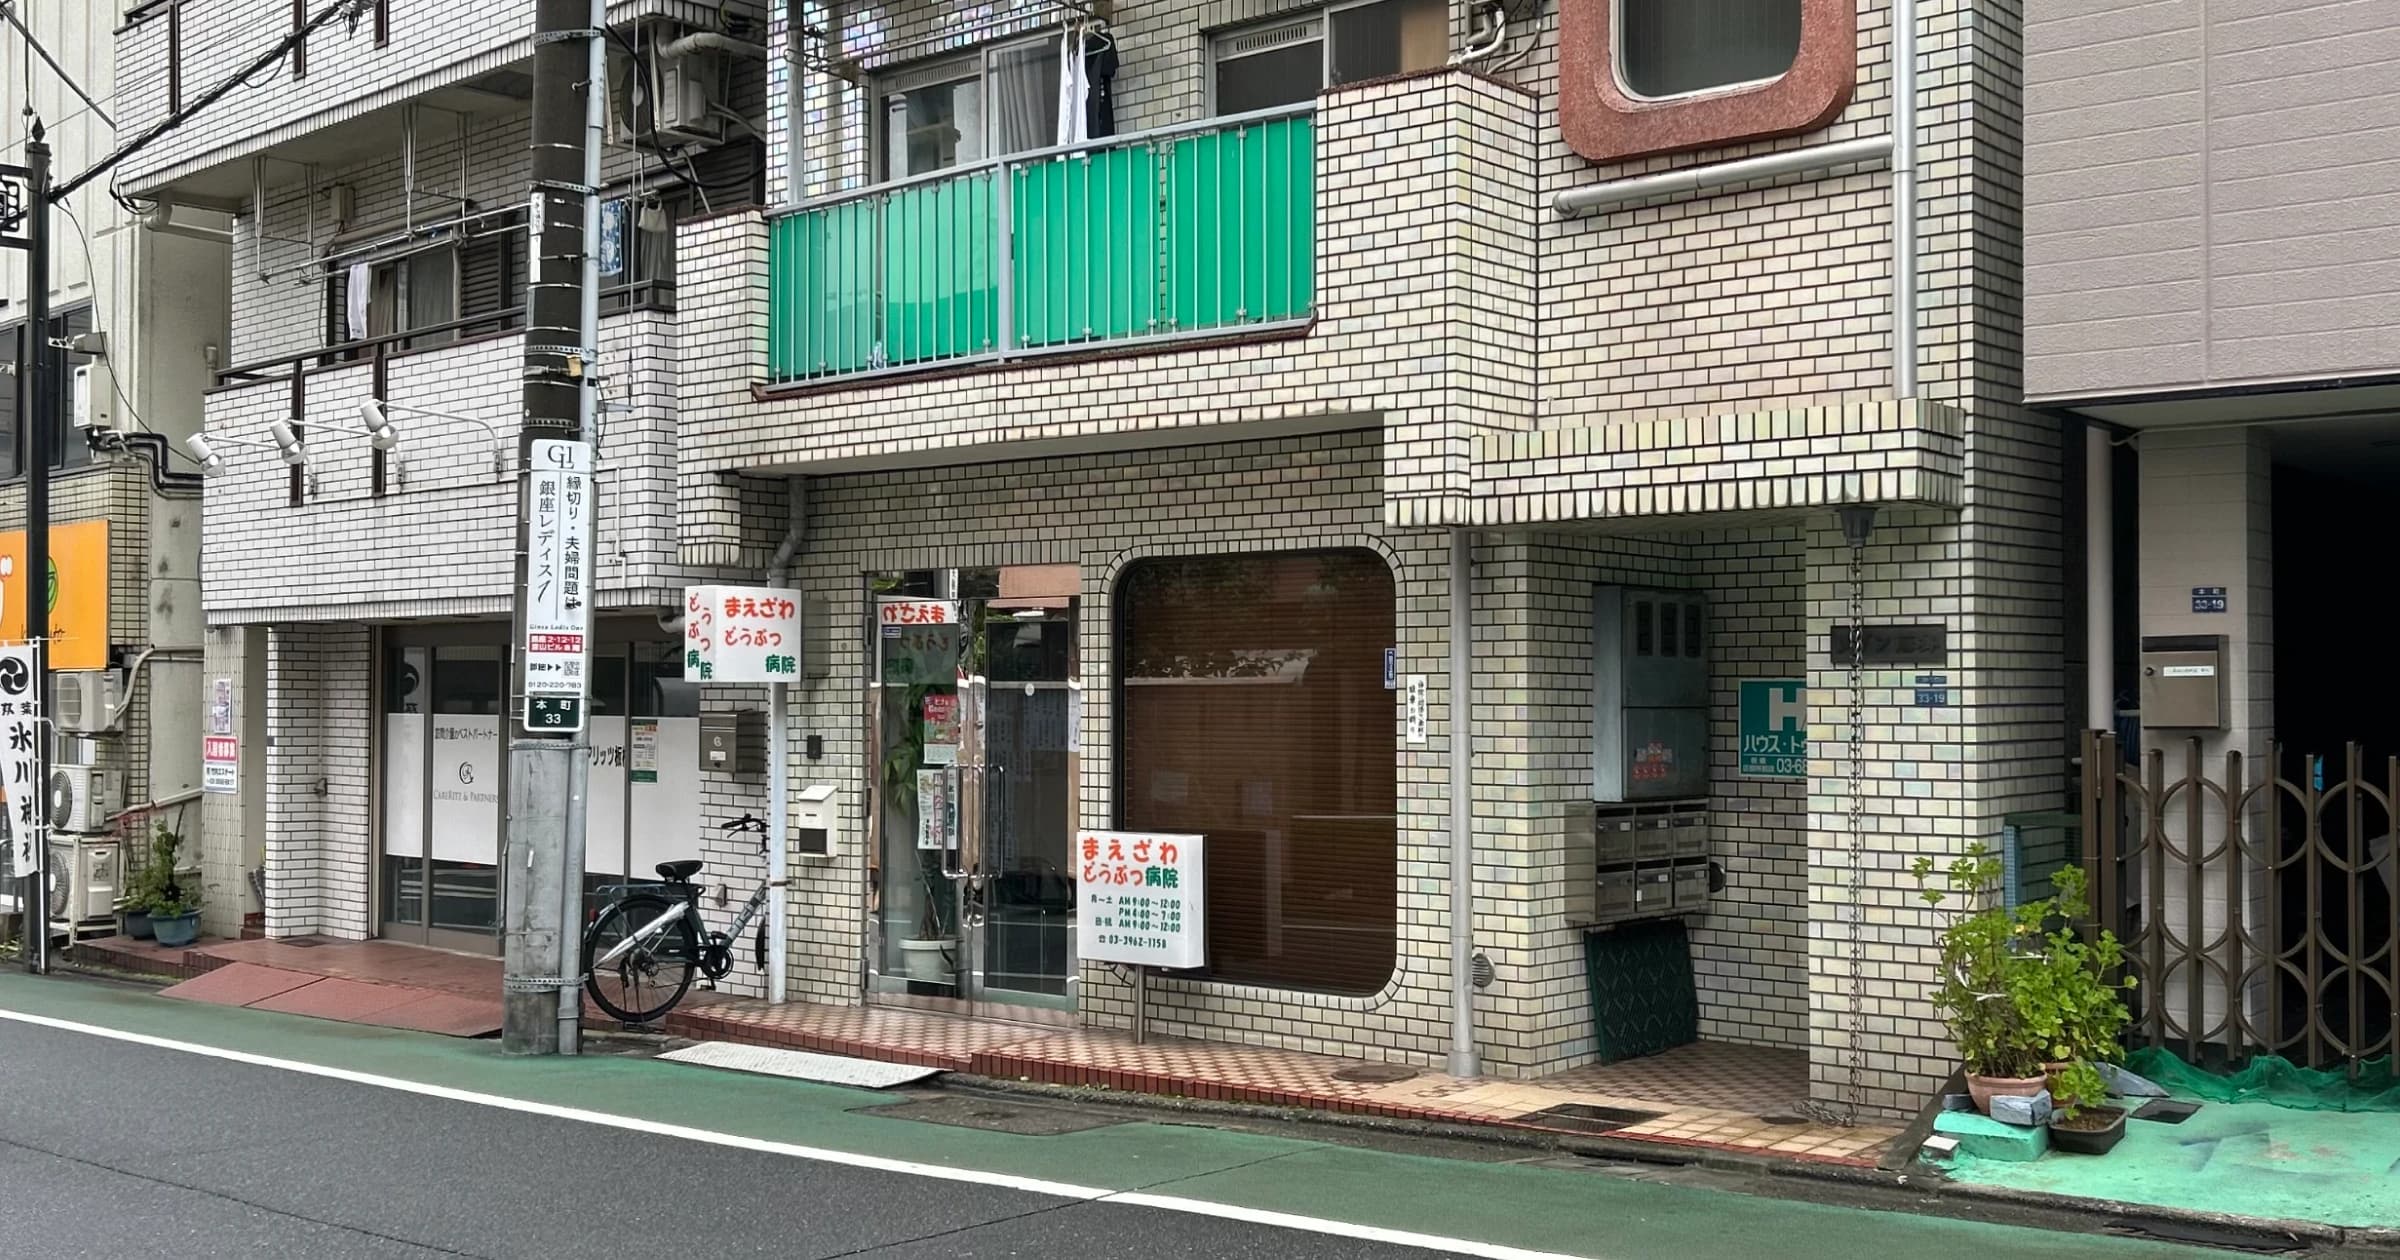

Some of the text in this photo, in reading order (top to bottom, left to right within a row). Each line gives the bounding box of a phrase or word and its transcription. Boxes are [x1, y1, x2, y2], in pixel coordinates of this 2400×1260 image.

[725, 597, 795, 619] まえざわ
[725, 627, 782, 646] どうぶつ
[765, 654, 796, 674] 病院
[536, 700, 571, 710] 本町
[545, 713, 561, 724] 33
[1082, 837, 1177, 864] まえざわ
[1083, 861, 1178, 888] どうぶつ病院
